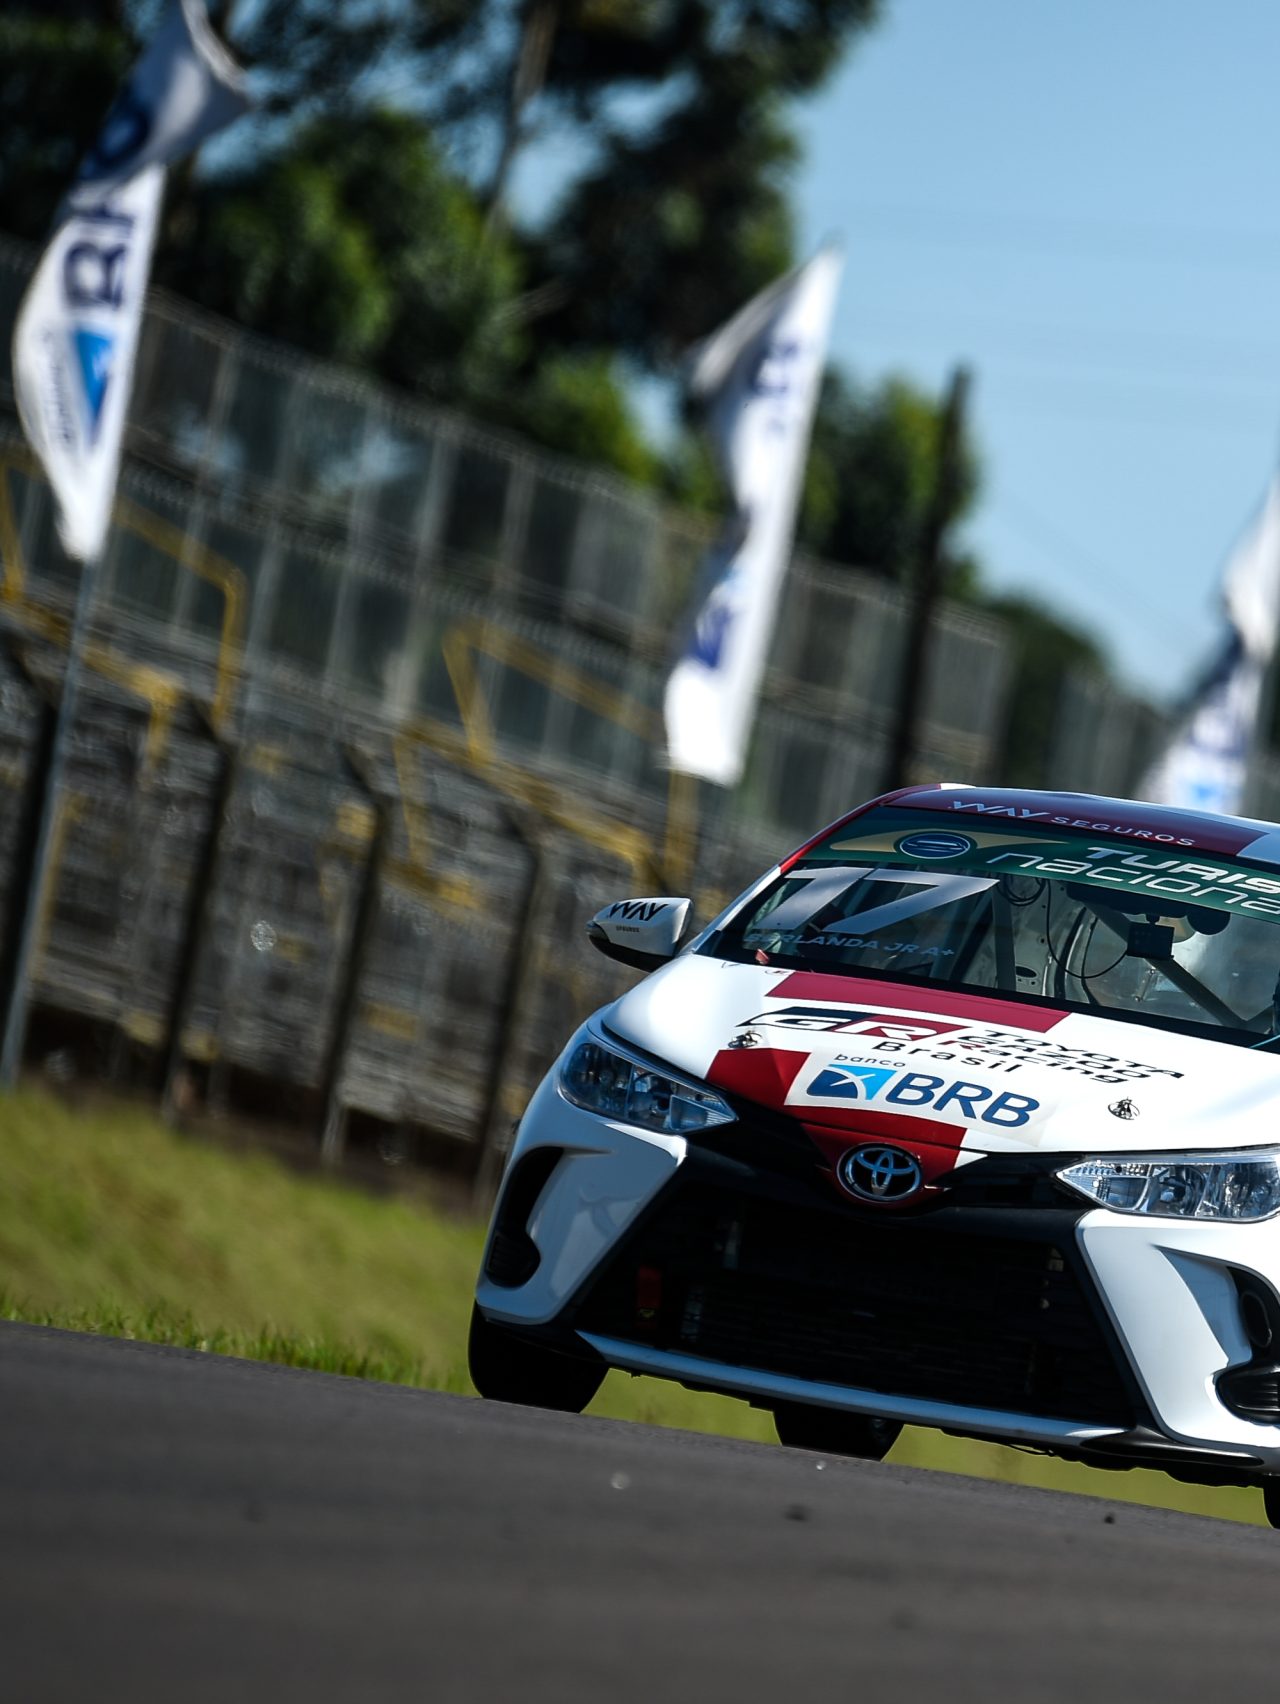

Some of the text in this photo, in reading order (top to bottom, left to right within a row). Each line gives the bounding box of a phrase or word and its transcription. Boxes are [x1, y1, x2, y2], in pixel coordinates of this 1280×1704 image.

[951, 800, 1197, 846] WAY SEGUROS
[608, 901, 670, 922] WAY
[751, 866, 1001, 936] 17
[748, 1011, 940, 1042] GR
[833, 1053, 907, 1069] banco
[871, 1041, 1024, 1073] Brasil
[936, 1040, 1130, 1084] Racing
[984, 1029, 1186, 1079] TOYOTA
[885, 1072, 1042, 1128] BRB
